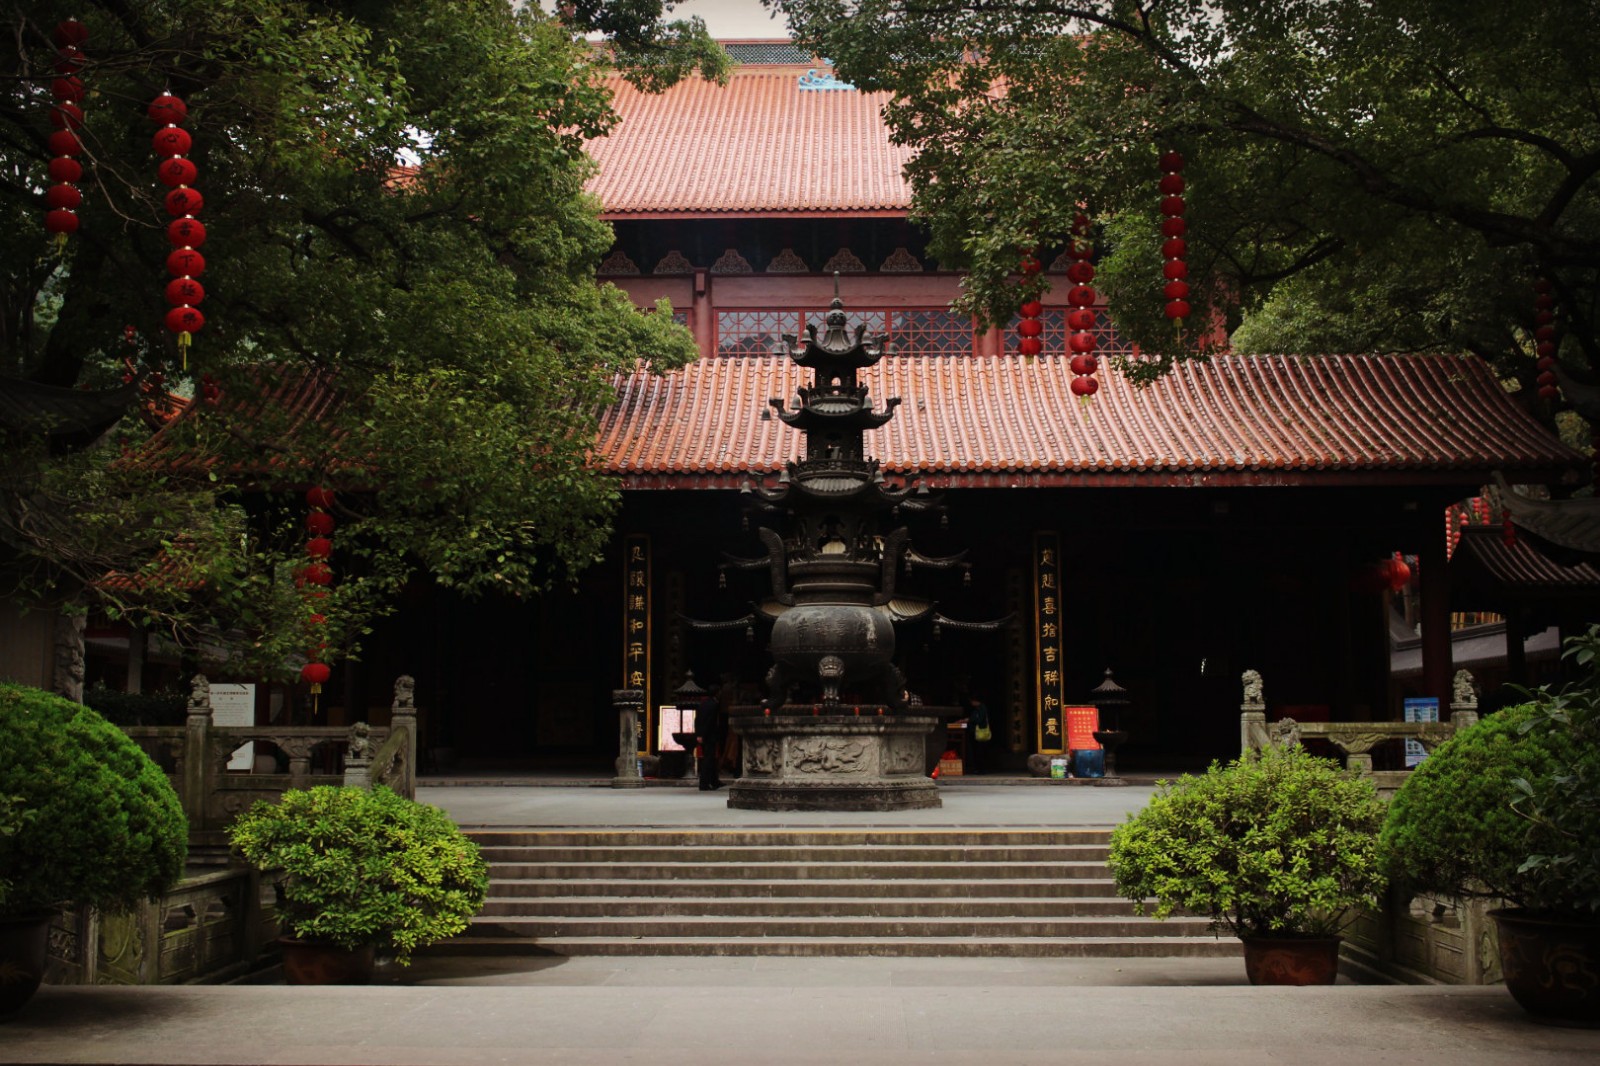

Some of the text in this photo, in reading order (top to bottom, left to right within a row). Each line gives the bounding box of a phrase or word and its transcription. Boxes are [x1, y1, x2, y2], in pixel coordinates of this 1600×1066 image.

[628, 545, 645, 739] 忍讓謙和平安
